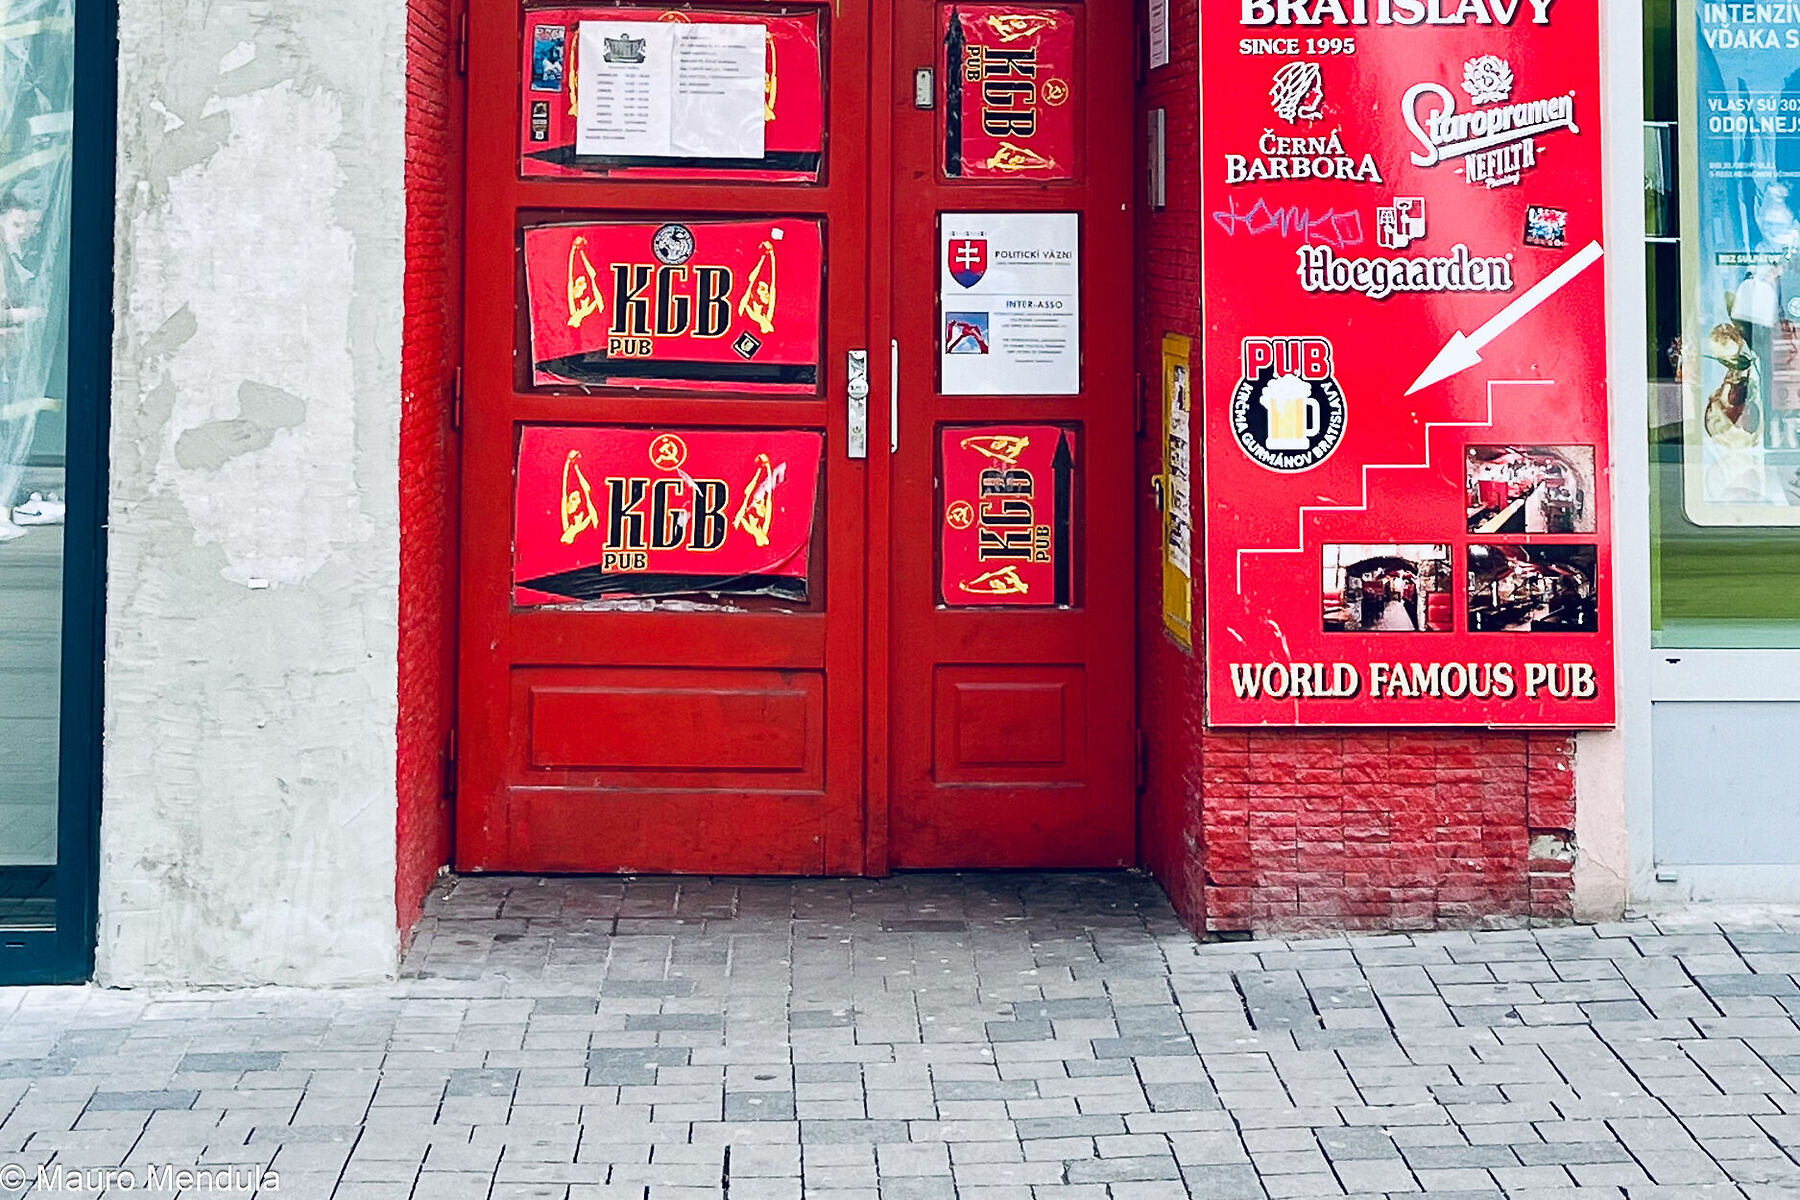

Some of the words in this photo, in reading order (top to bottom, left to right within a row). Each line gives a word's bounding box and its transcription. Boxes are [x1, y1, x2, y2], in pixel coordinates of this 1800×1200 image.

[1239, 38, 1300, 55] SINCE
[1306, 38, 1355, 55] 1995
[1703, 22, 1781, 49] VĎAKA
[965, 44, 982, 82] PUB
[981, 46, 1037, 138] KGB
[1708, 98, 1753, 112] VLASY
[1757, 95, 1777, 112] SÚ
[1259, 128, 1344, 156] ČERNÁ
[1401, 82, 1580, 168] Staropramen
[1709, 116, 1800, 133] ODOLNEJ
[1225, 153, 1383, 184] BARBORA
[1296, 243, 1513, 299] Hoegaarden
[607, 263, 734, 337] KGB
[608, 337, 653, 357] PUB
[1243, 337, 1334, 381] PUB
[1235, 382, 1254, 434] KRČMA
[1312, 382, 1342, 458] BRATISLAVY
[1242, 432, 1312, 468] GURMÁNOV
[602, 477, 729, 552] KGB
[978, 468, 1035, 563] KGB
[602, 551, 648, 571] PUB
[1034, 524, 1051, 563] PUB
[1230, 662, 1358, 698] WORLD
[1370, 662, 1516, 698] FAMOUS
[1526, 662, 1597, 699] PUB
